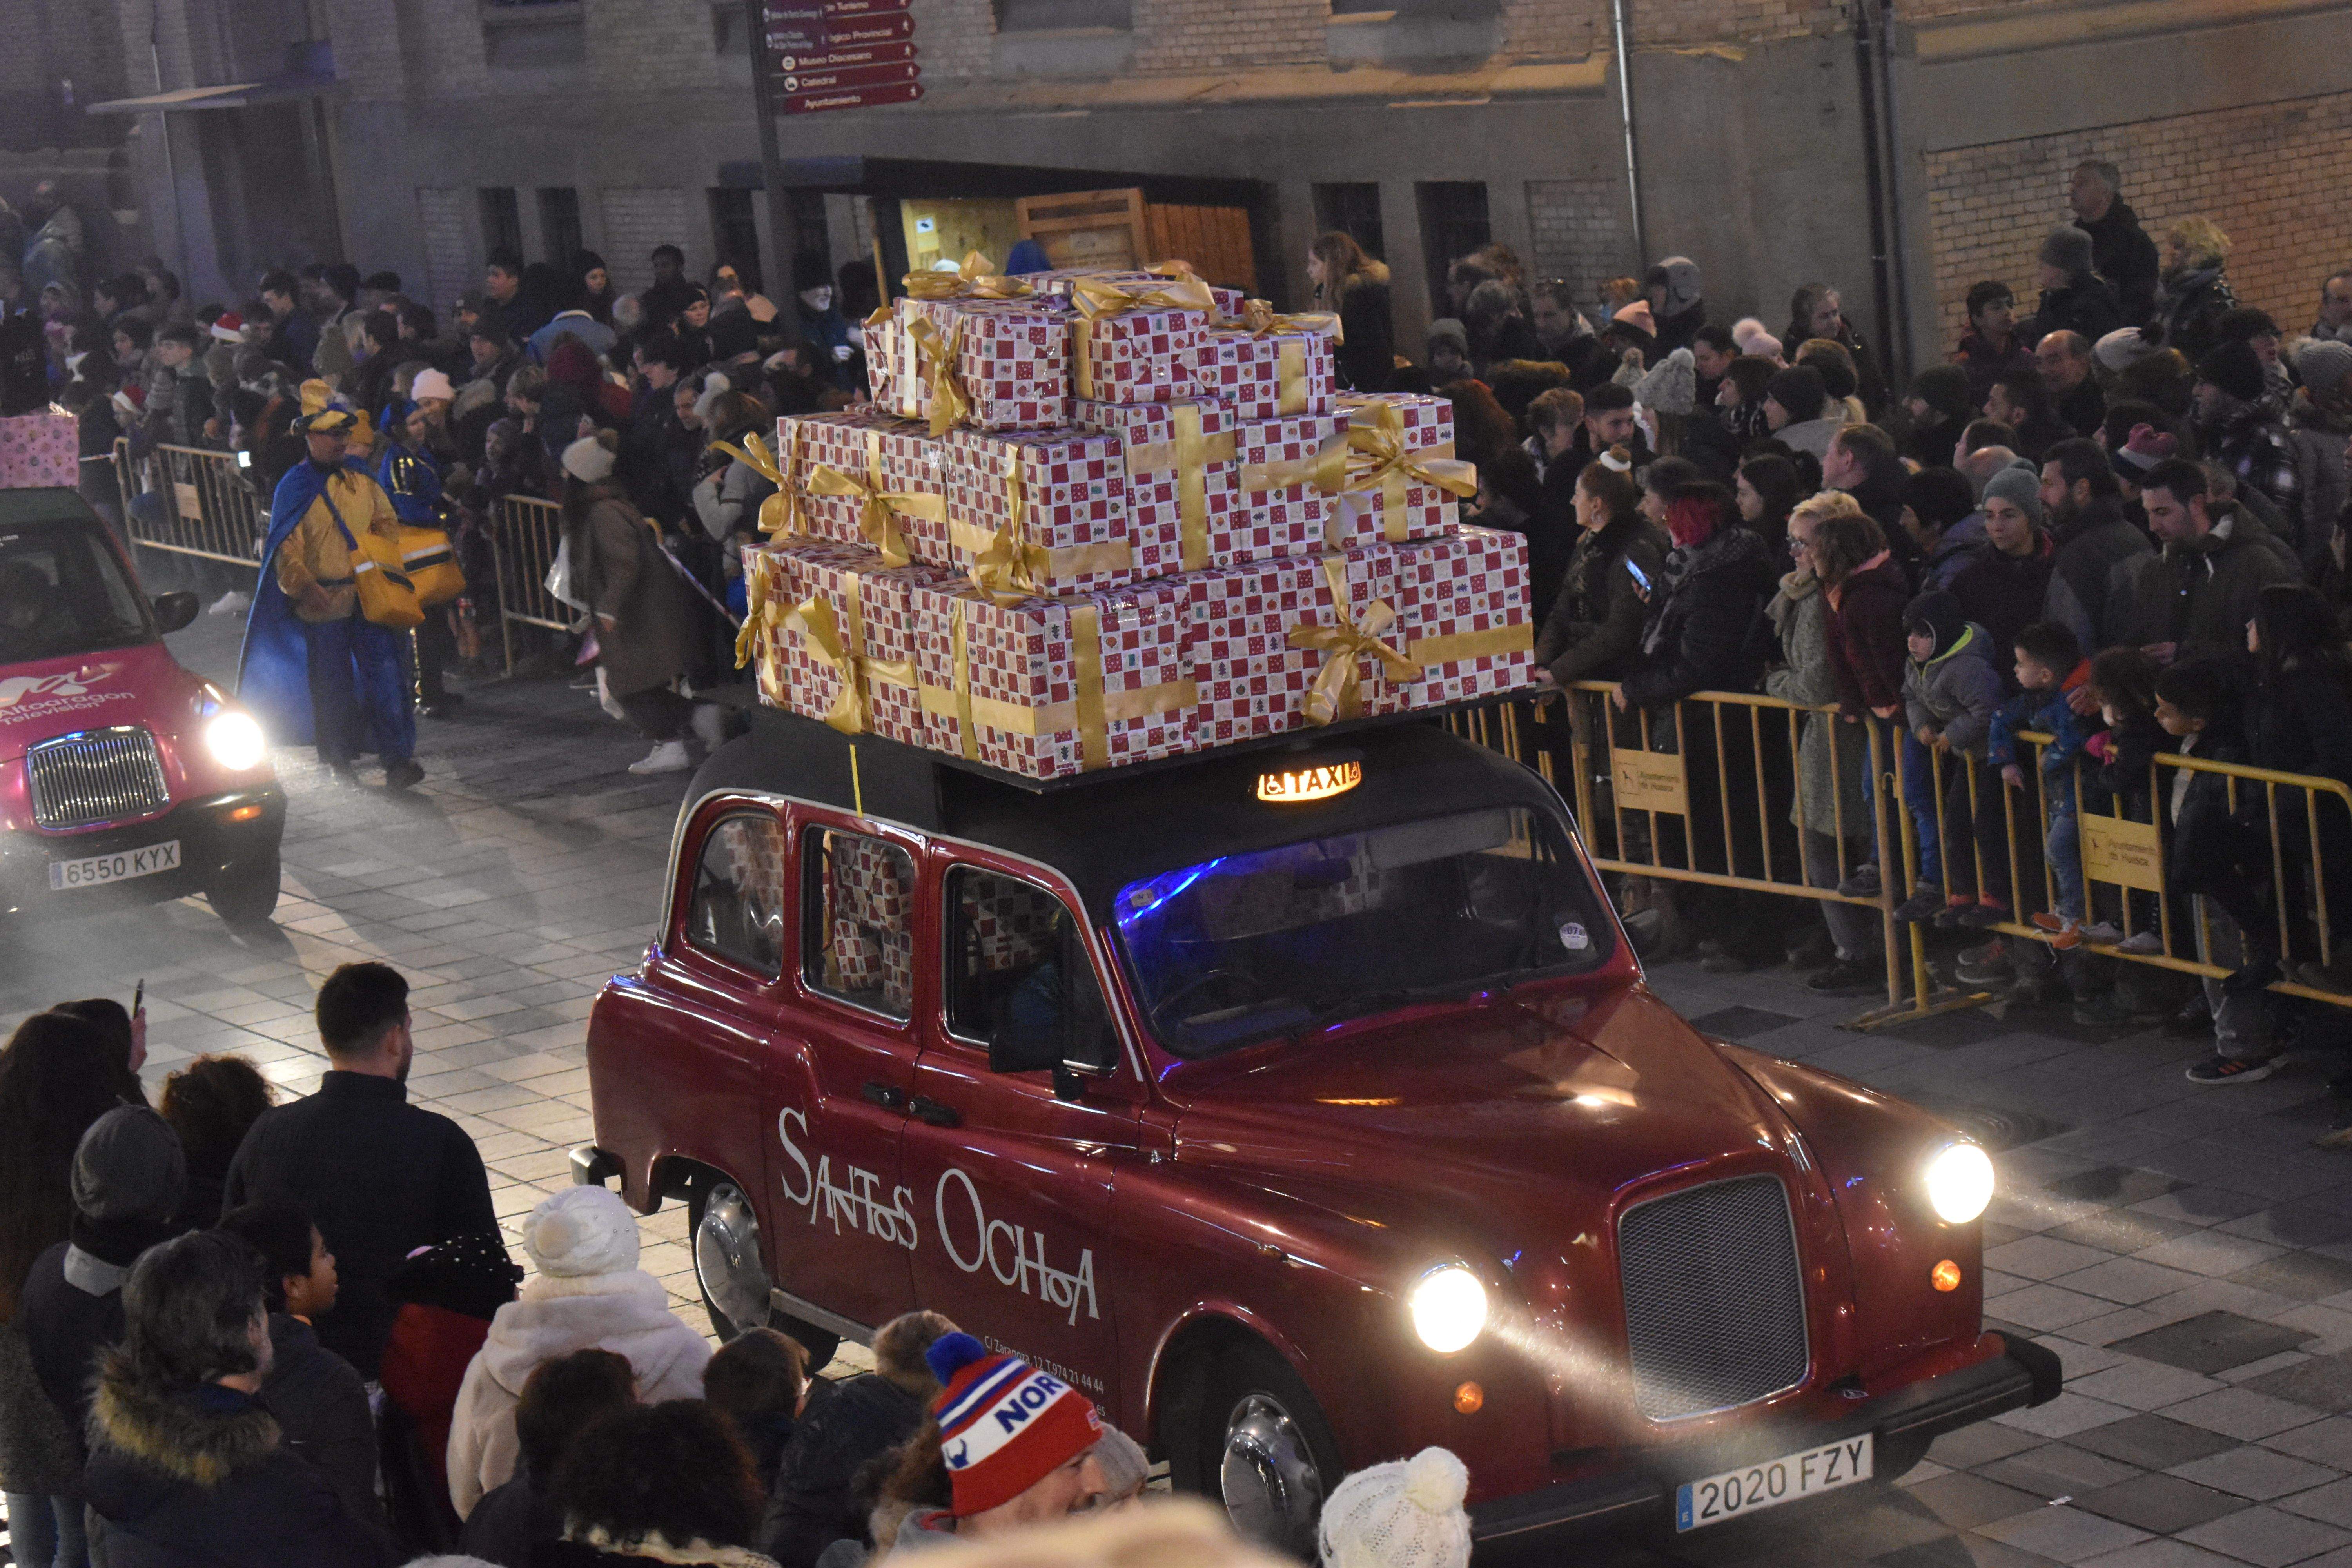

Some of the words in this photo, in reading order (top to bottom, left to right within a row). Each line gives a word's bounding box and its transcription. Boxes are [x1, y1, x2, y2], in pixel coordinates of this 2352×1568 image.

[804, 96, 861, 109] Ayuntamiento
[1289, 763, 1347, 794] TAXI
[66, 857, 126, 884] 6550
[134, 845, 175, 873] KYX
[779, 1107, 917, 1250] SANTOS
[936, 1168, 1100, 1326] OCHOA
[1069, 1369, 1079, 1384] 21
[1081, 1374, 1092, 1389] 44
[1093, 1379, 1104, 1394] 44
[994, 1375, 1063, 1434] NOR
[1700, 1463, 1787, 1519] 2020
[1801, 1440, 1864, 1491] FZY
